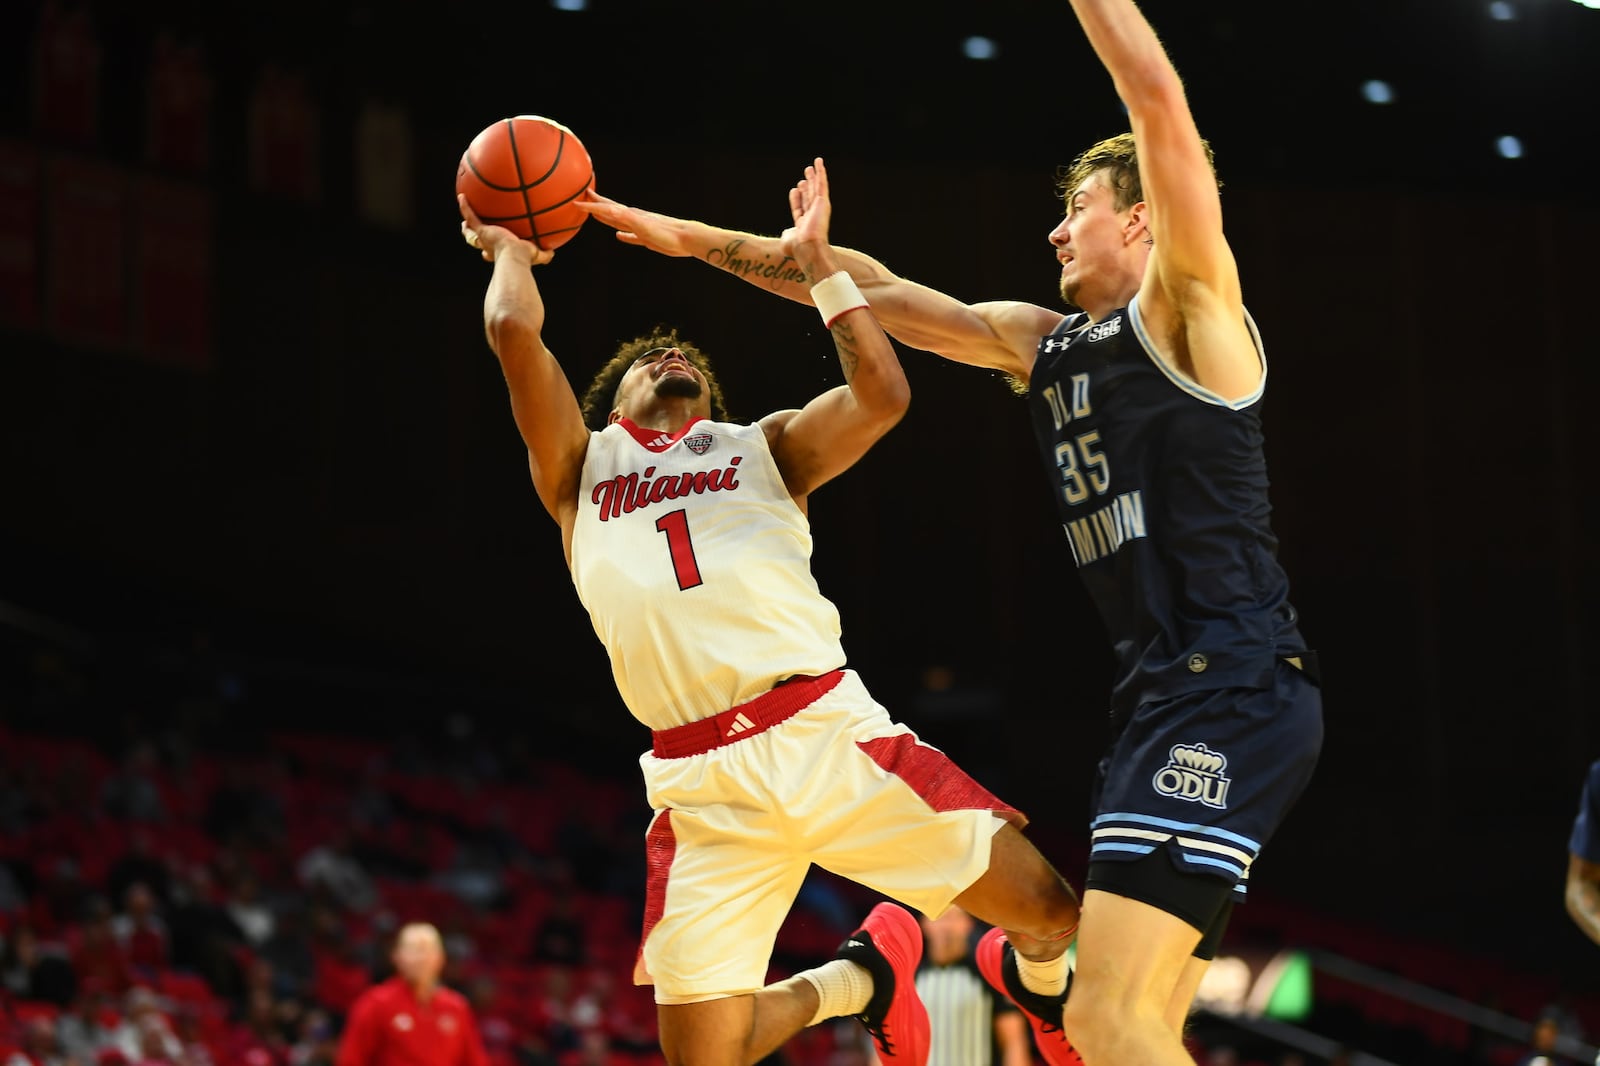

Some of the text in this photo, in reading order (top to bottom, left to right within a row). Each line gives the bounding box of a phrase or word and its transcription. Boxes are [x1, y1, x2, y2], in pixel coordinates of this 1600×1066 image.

[591, 456, 743, 522] Miami
[1055, 429, 1111, 506] 35
[655, 508, 704, 592] 1
[1153, 766, 1231, 809] ODU
